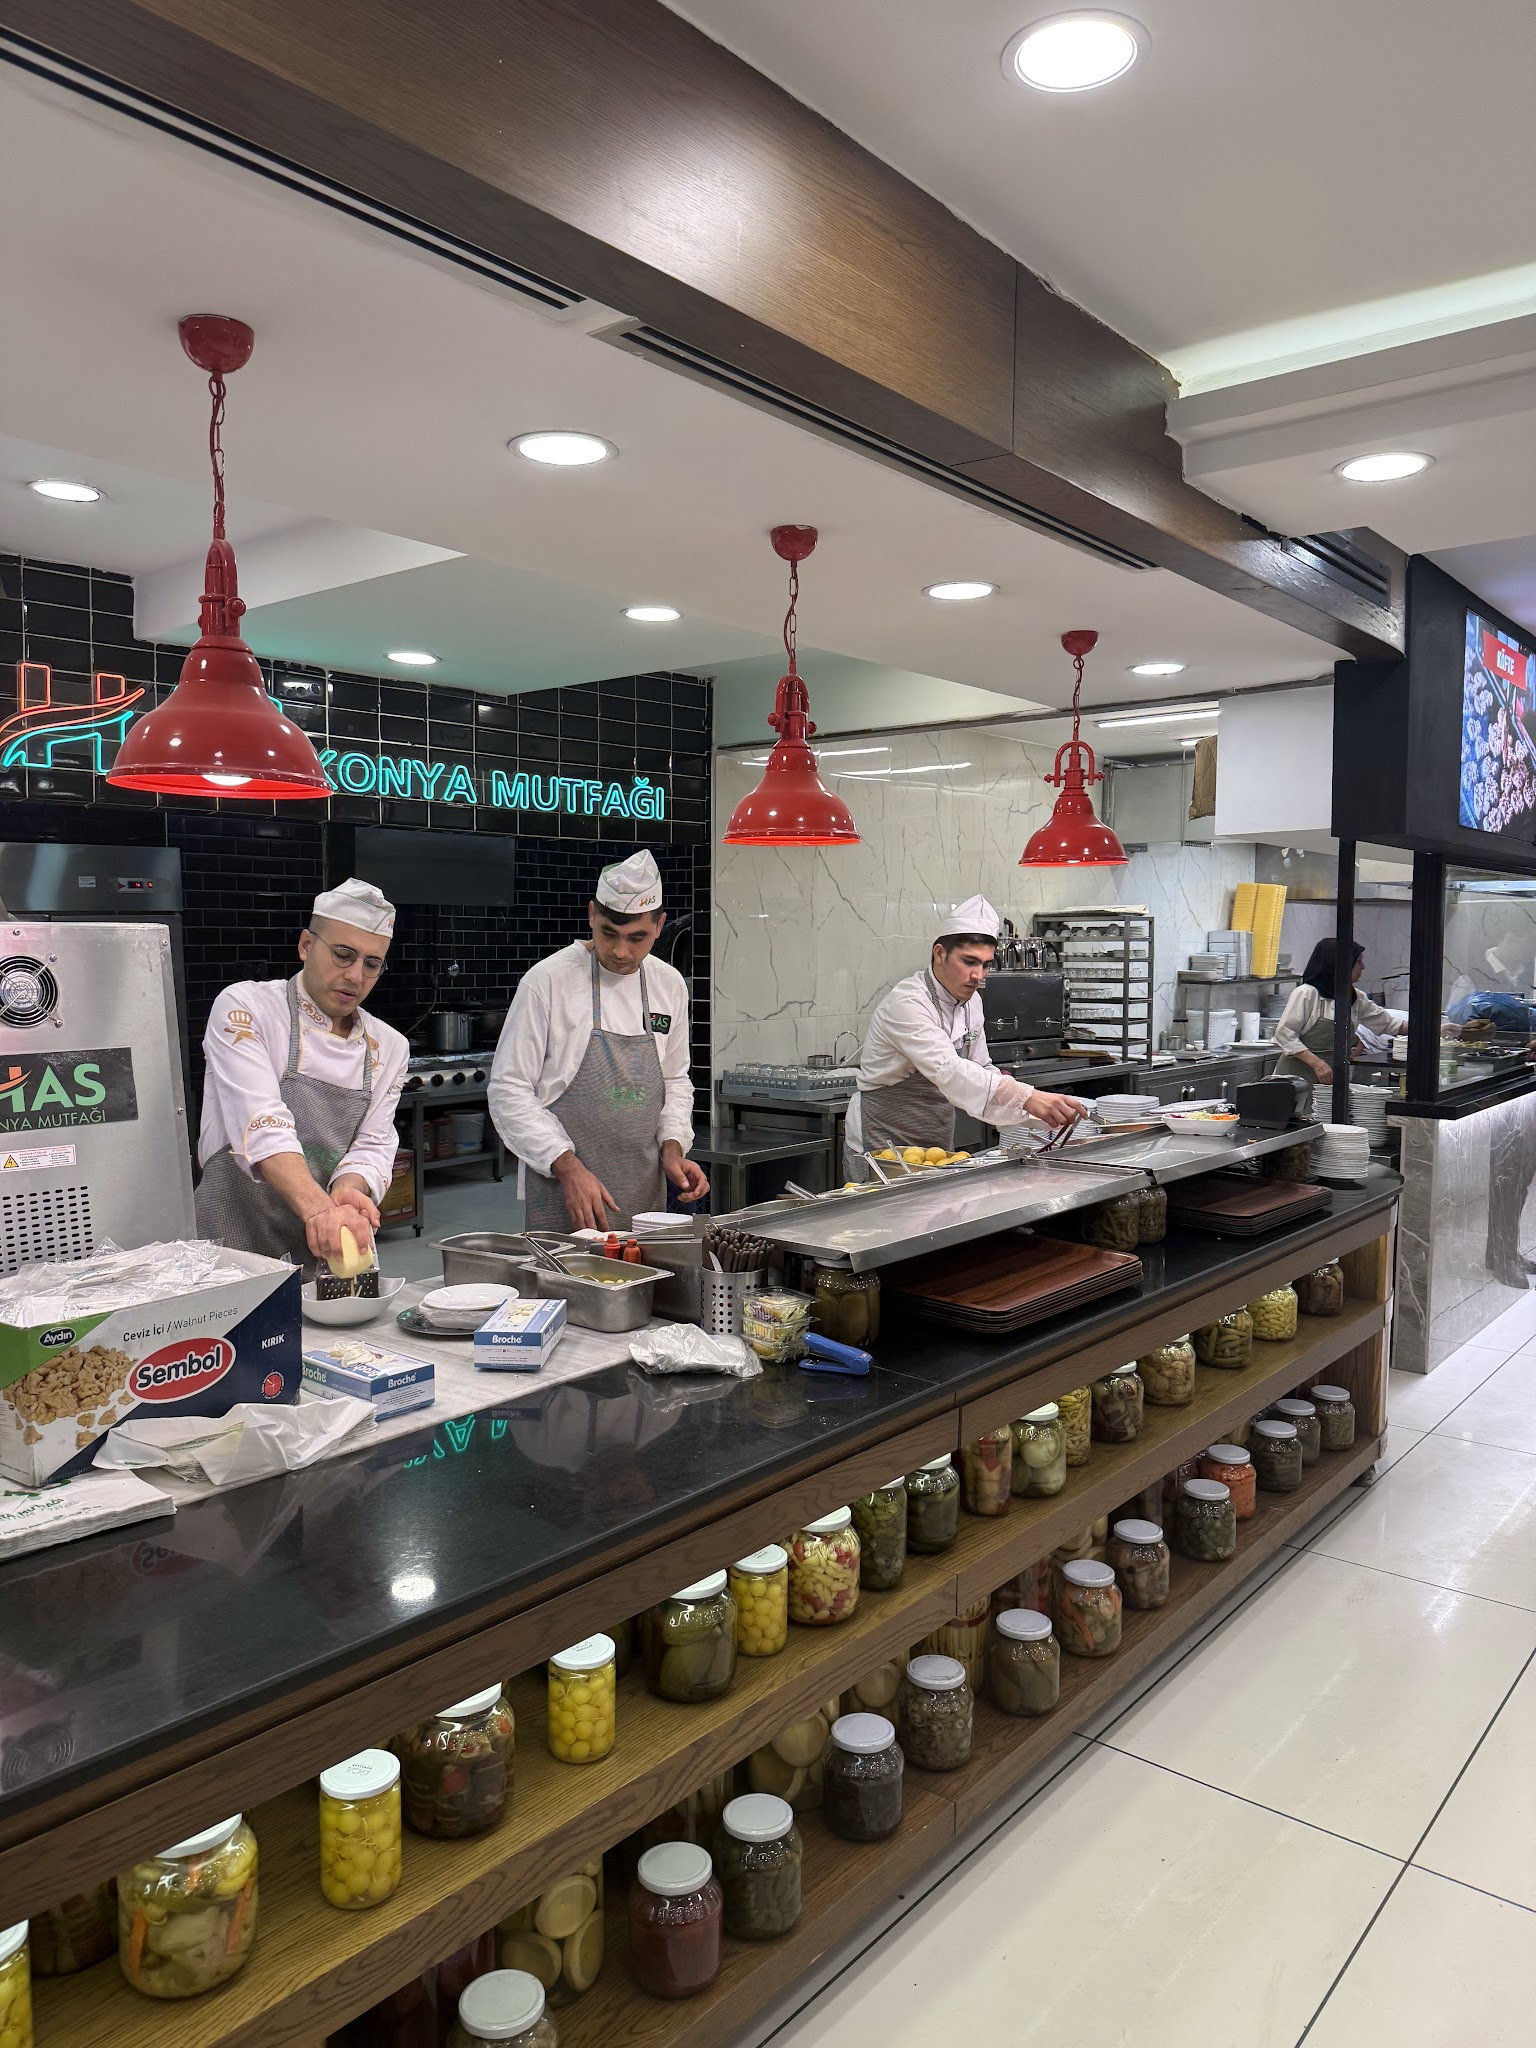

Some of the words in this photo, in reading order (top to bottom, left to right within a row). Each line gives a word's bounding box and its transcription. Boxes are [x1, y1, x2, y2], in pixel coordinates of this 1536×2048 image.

[491, 771, 665, 821] MUTFAĞI
[38, 1107, 106, 1128] MUTFAĞI
[123, 1328, 151, 1342] Ceviz
[153, 1323, 165, 1336] İçi
[173, 1314, 207, 1330] Walnut
[209, 1307, 238, 1322] Pieces
[261, 1333, 285, 1350] KIRIK
[492, 1335, 523, 1344] Broche
[137, 1344, 223, 1389] Sembol
[387, 1373, 417, 1389] Broche
